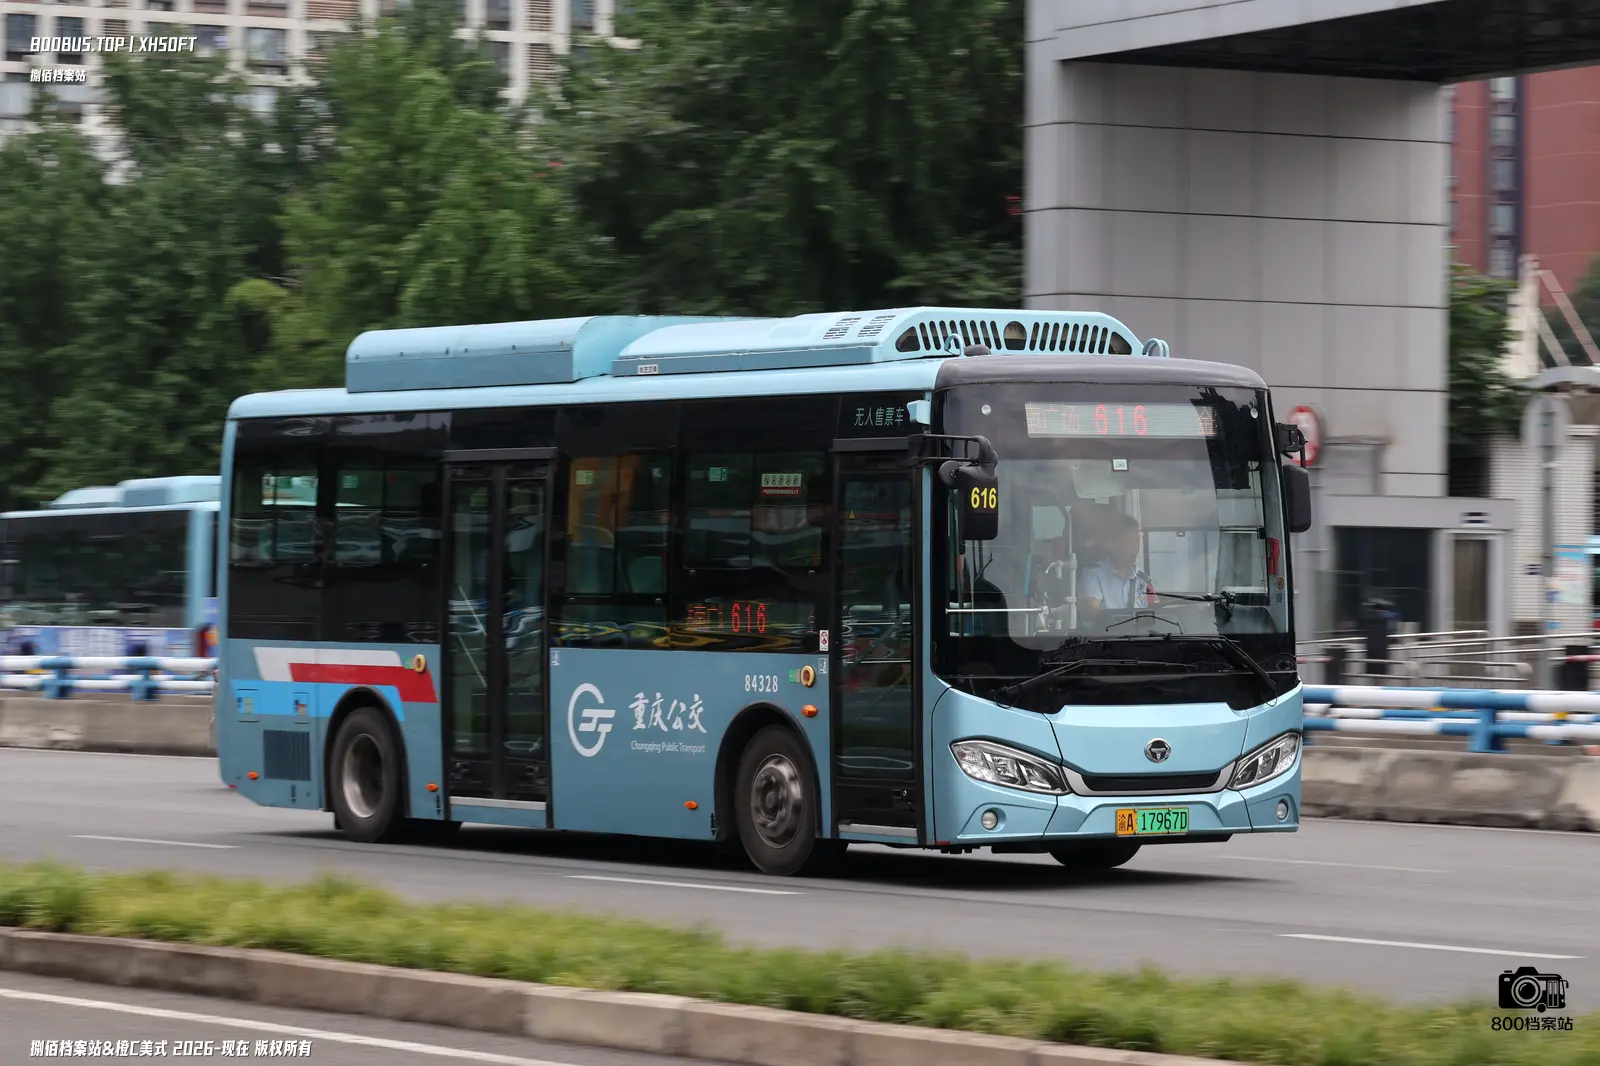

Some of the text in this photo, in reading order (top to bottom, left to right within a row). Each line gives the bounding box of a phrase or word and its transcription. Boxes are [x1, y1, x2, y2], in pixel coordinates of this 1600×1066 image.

[854, 406, 905, 427] 无人售票车
[1094, 404, 1147, 436] 616
[970, 486, 997, 509] 616
[731, 602, 767, 634] 616
[744, 674, 779, 693] 84328
[628, 691, 708, 734] 重庆公交
[630, 740, 706, 756] Chongqing Public Transport
[1141, 811, 1188, 831] 17967D
